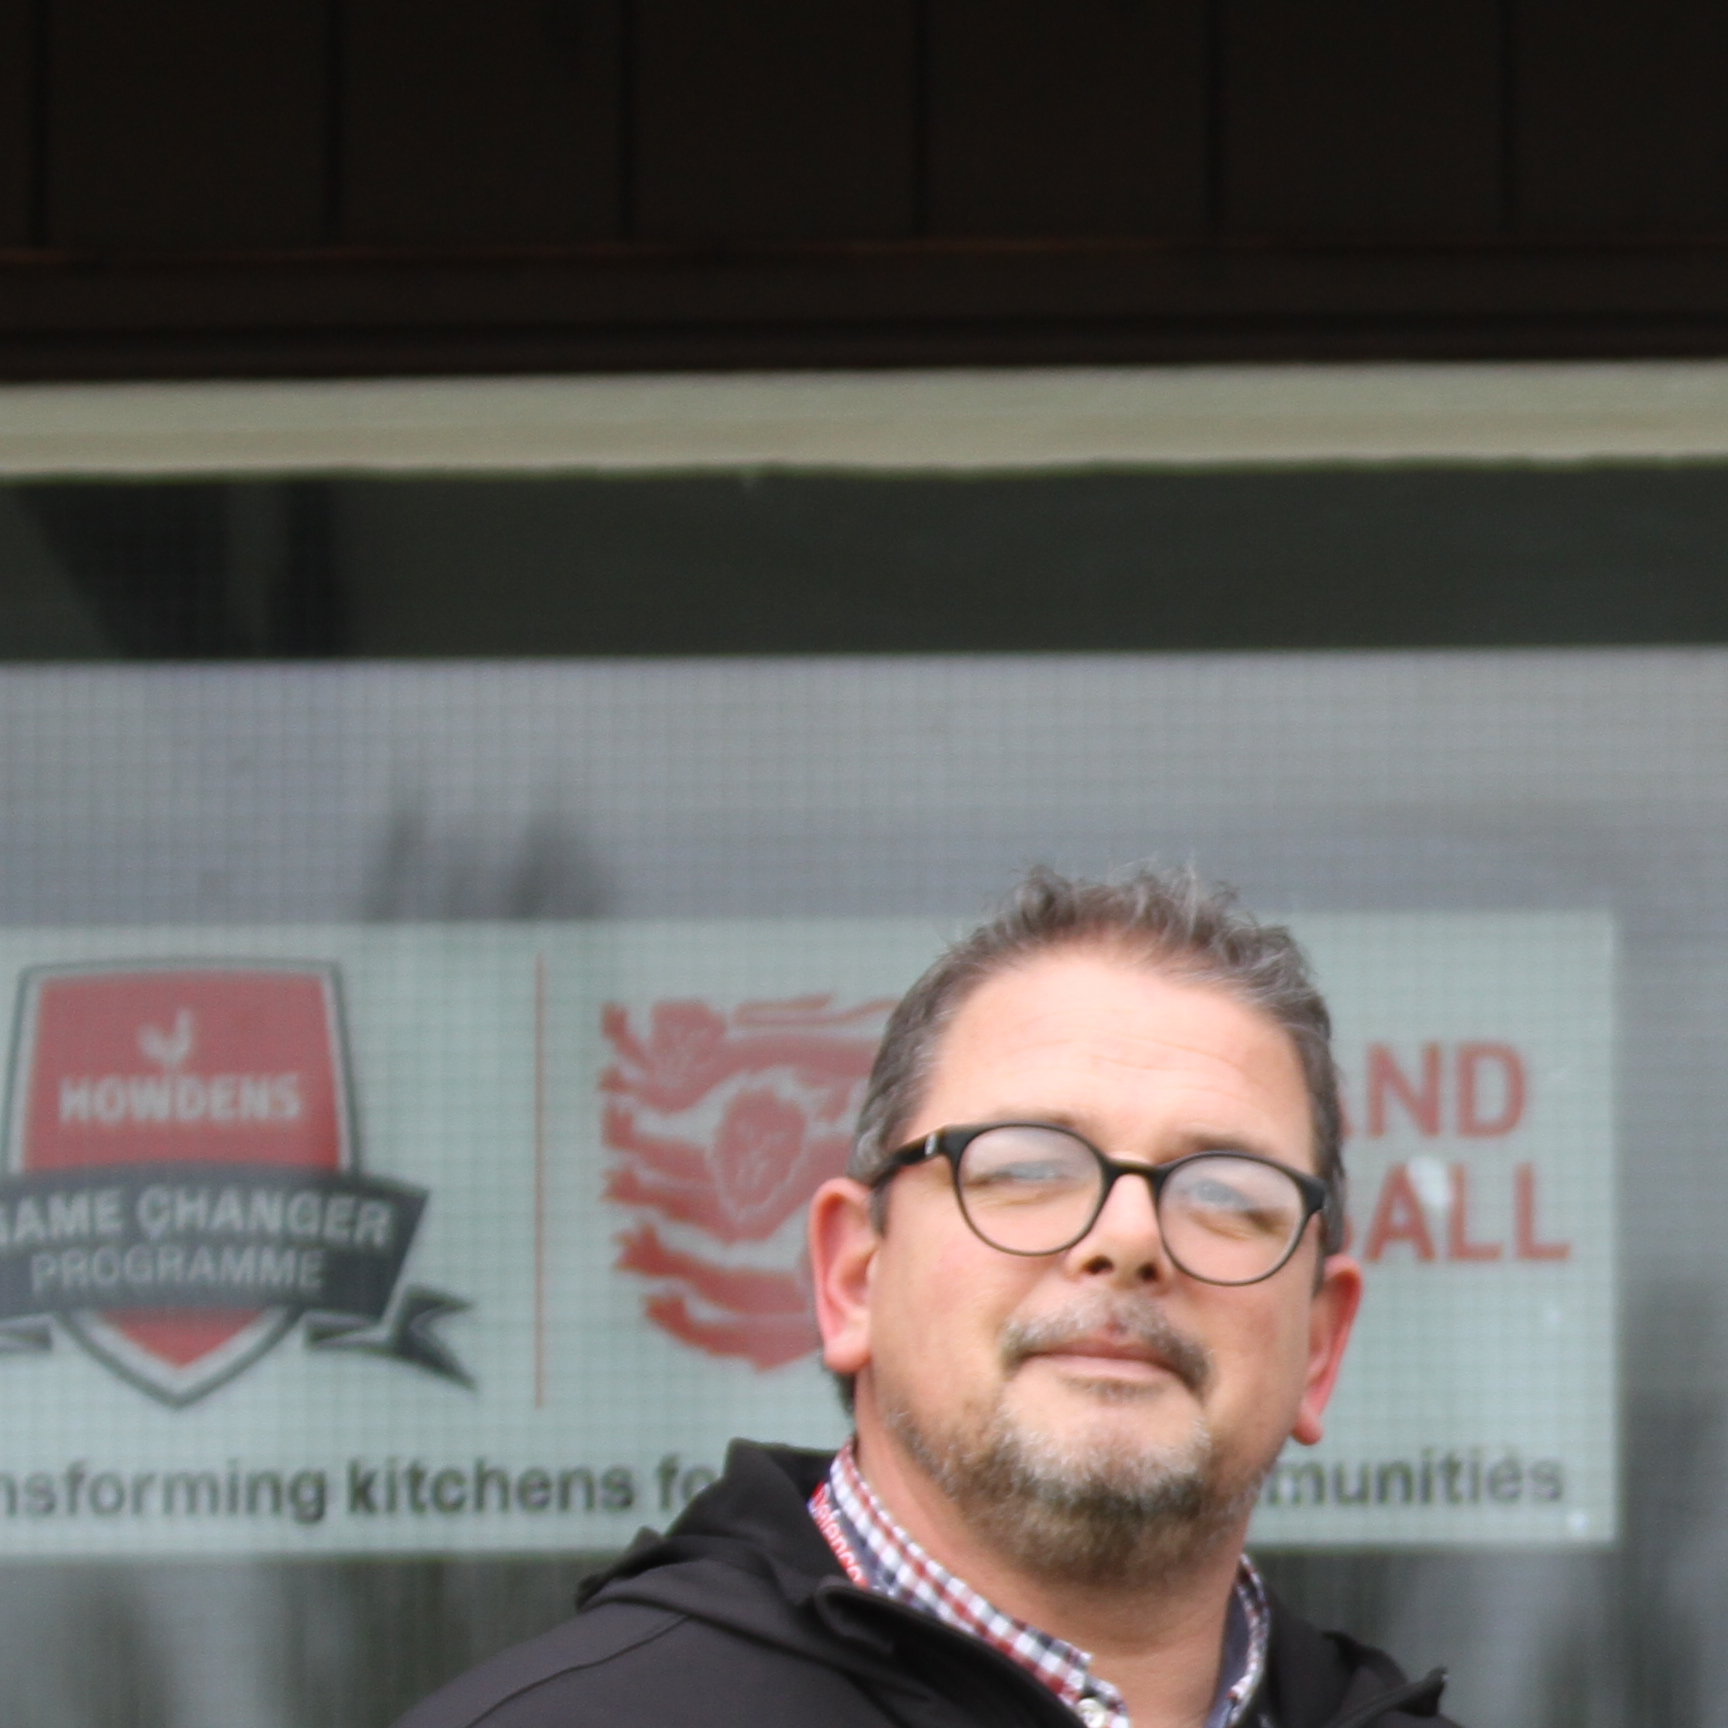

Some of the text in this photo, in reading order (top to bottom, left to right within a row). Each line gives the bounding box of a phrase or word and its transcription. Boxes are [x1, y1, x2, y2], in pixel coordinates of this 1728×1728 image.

[59, 1072, 302, 1124] HOWDENS
[0, 1183, 395, 1249] AME CHANGER
[30, 1241, 326, 1293] PROGRAMME
[346, 1456, 636, 1515] kitchens
[655, 1454, 724, 1513] fo
